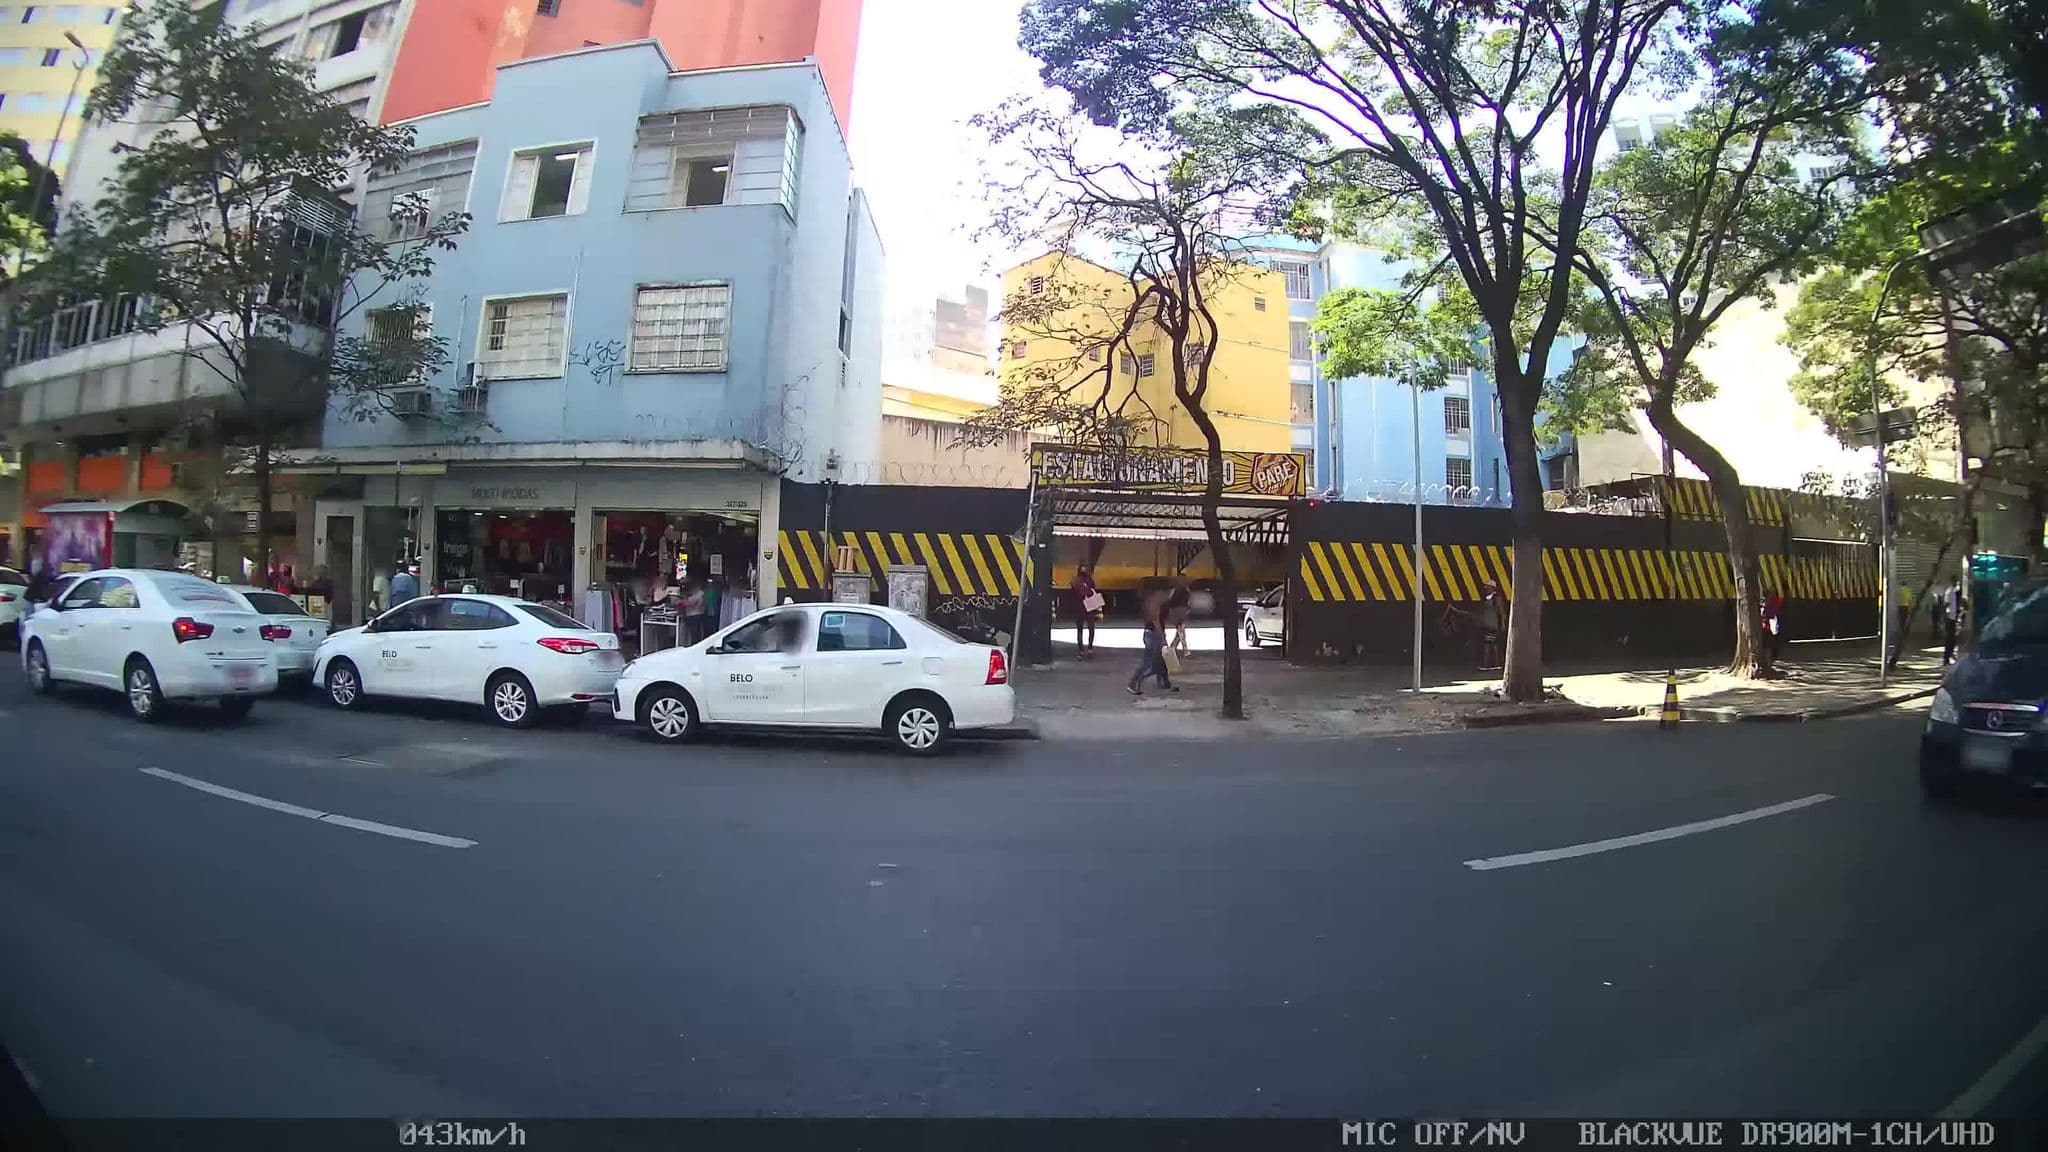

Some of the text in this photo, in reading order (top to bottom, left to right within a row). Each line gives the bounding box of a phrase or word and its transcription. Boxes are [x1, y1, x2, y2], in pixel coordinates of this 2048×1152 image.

[1042, 451, 1235, 486] ESTACIONAMENO
[1256, 461, 1296, 488] PARE
[730, 673, 754, 683] BELO
